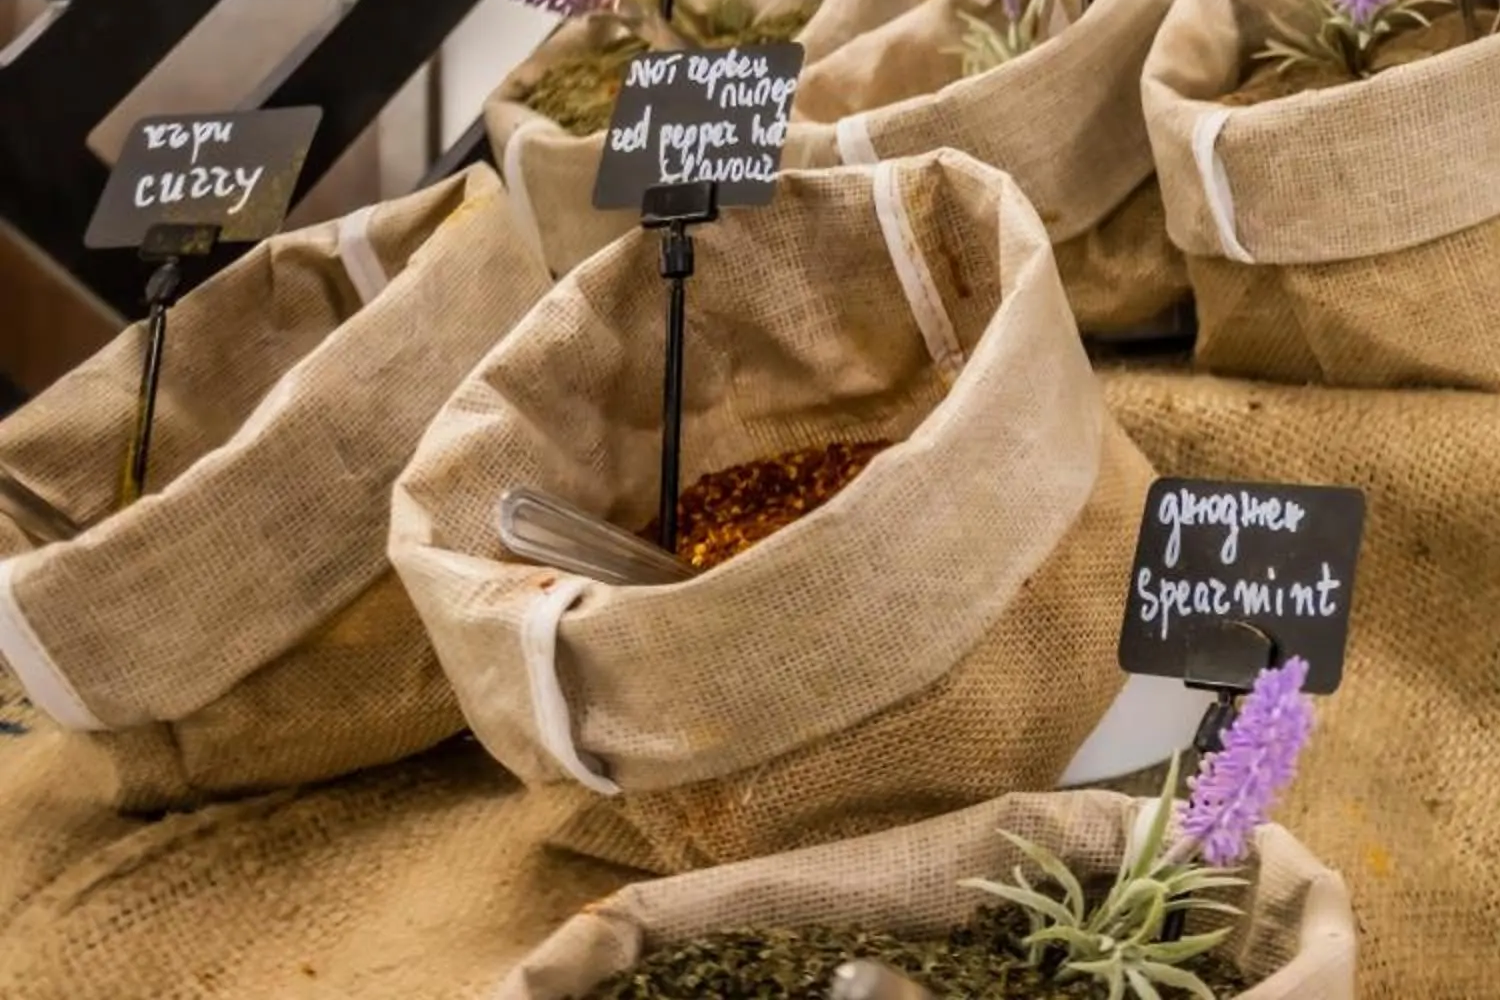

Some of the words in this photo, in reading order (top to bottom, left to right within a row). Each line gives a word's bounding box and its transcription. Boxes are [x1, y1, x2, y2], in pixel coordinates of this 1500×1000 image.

[143, 121, 234, 164] къри
[611, 105, 652, 152] red
[659, 120, 738, 170] pepper
[135, 165, 264, 214] curry
